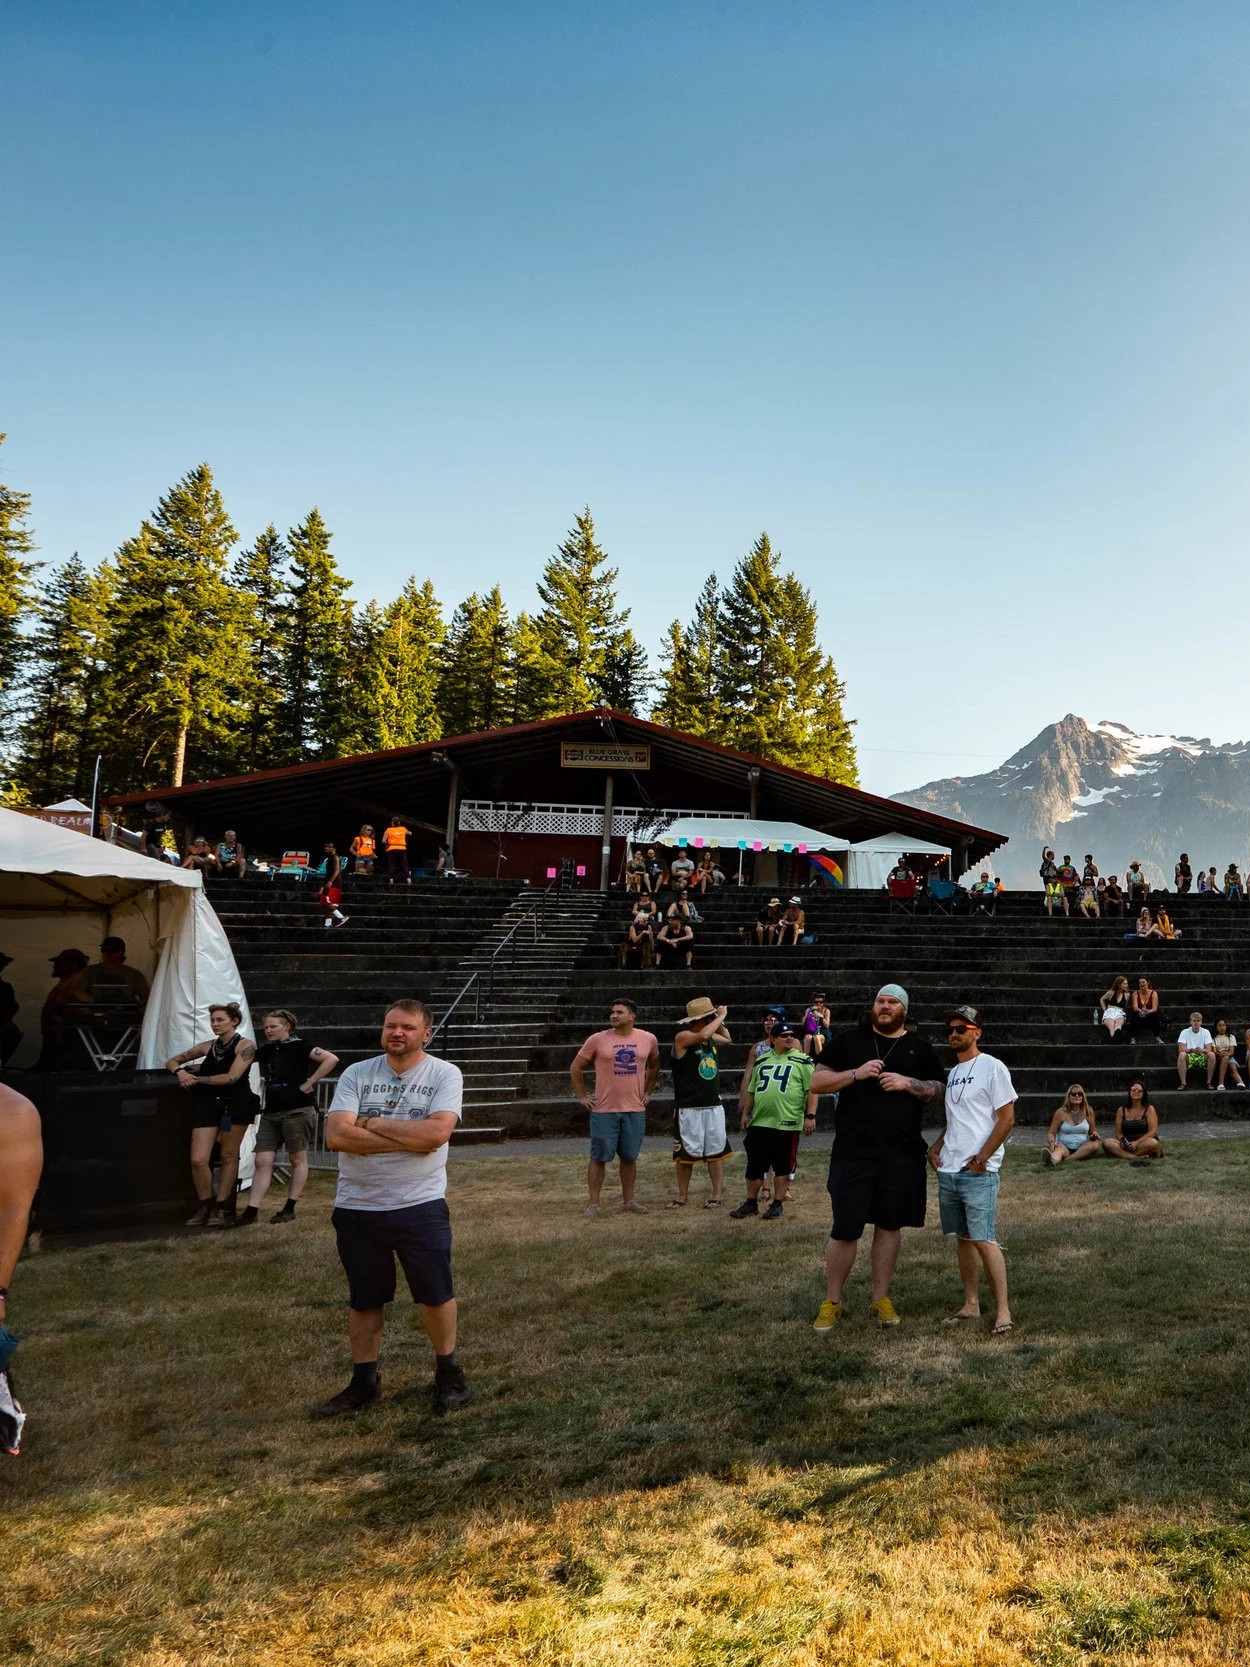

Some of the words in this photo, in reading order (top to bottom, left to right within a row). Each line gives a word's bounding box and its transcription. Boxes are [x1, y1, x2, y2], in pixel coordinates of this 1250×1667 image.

[757, 1064, 793, 1094] 54
[363, 1084, 406, 1094] RGGIS
[409, 1084, 434, 1097] RIGS
